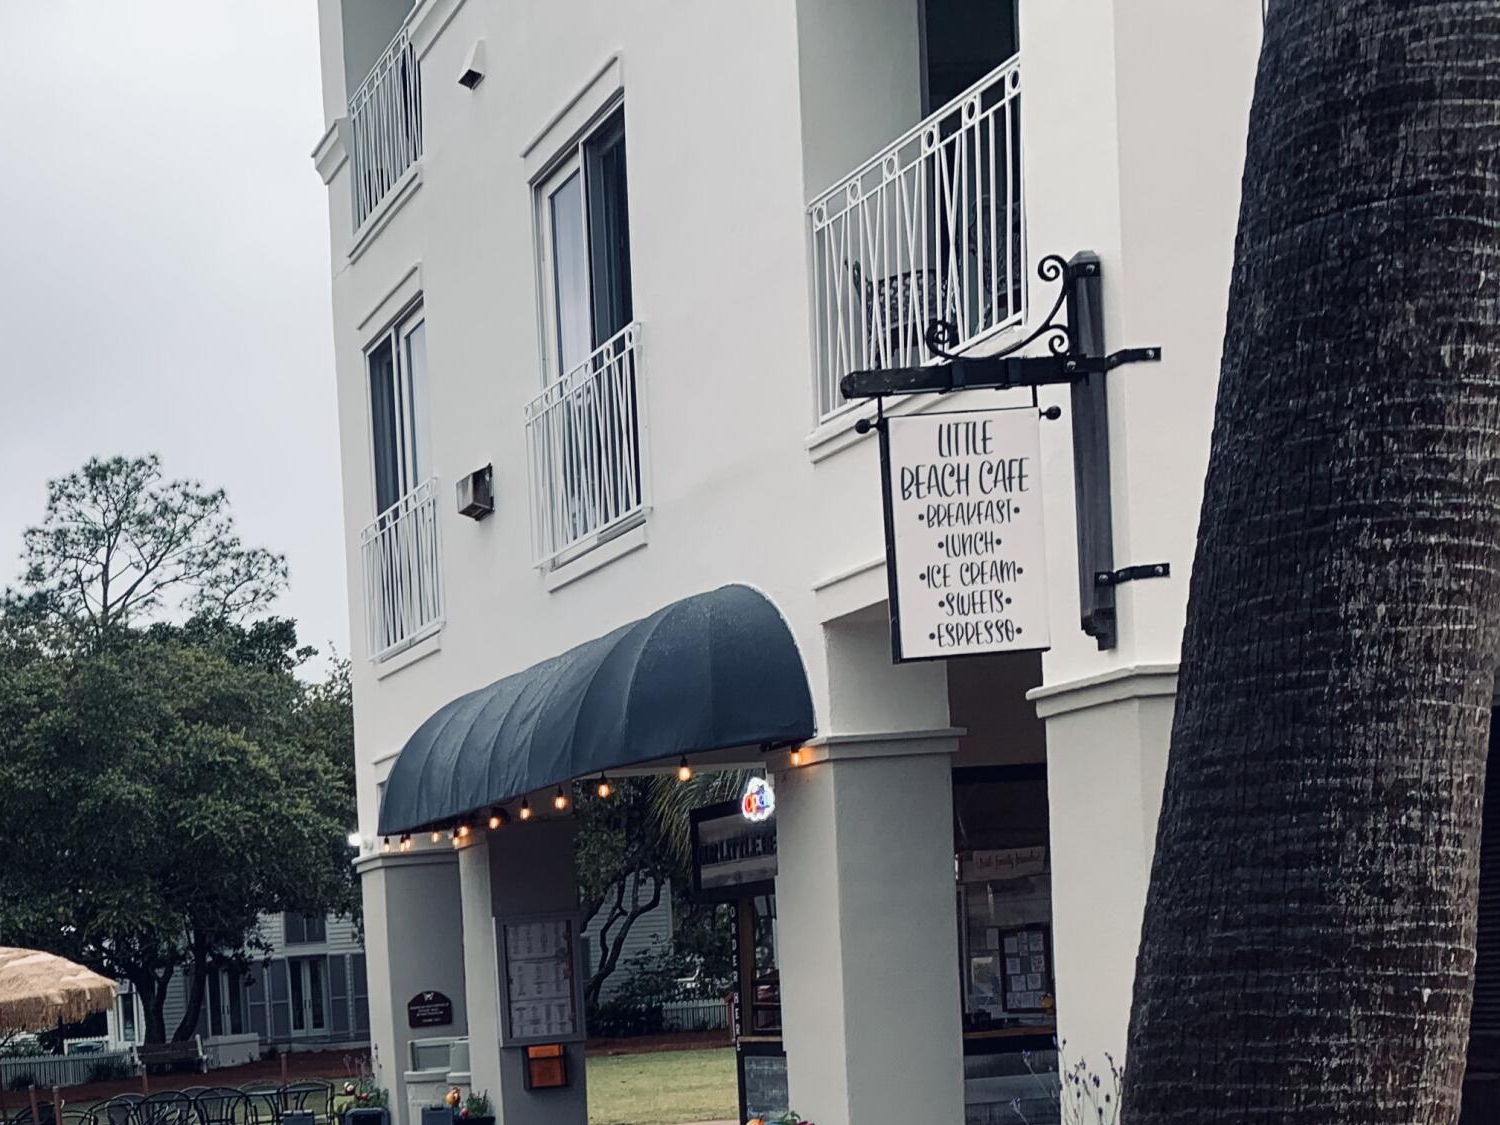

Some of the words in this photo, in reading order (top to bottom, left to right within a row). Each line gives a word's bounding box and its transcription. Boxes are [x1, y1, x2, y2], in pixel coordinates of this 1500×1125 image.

[938, 420, 993, 458] LITTLE
[901, 463, 970, 500] BEACH
[979, 457, 1030, 495] CAFE
[926, 499, 1012, 528] BREAKFAST
[926, 563, 951, 588] ICE
[960, 560, 1017, 586] CREAM
[946, 589, 1004, 616] SWEETS
[937, 619, 1015, 648] ESPRESSO
